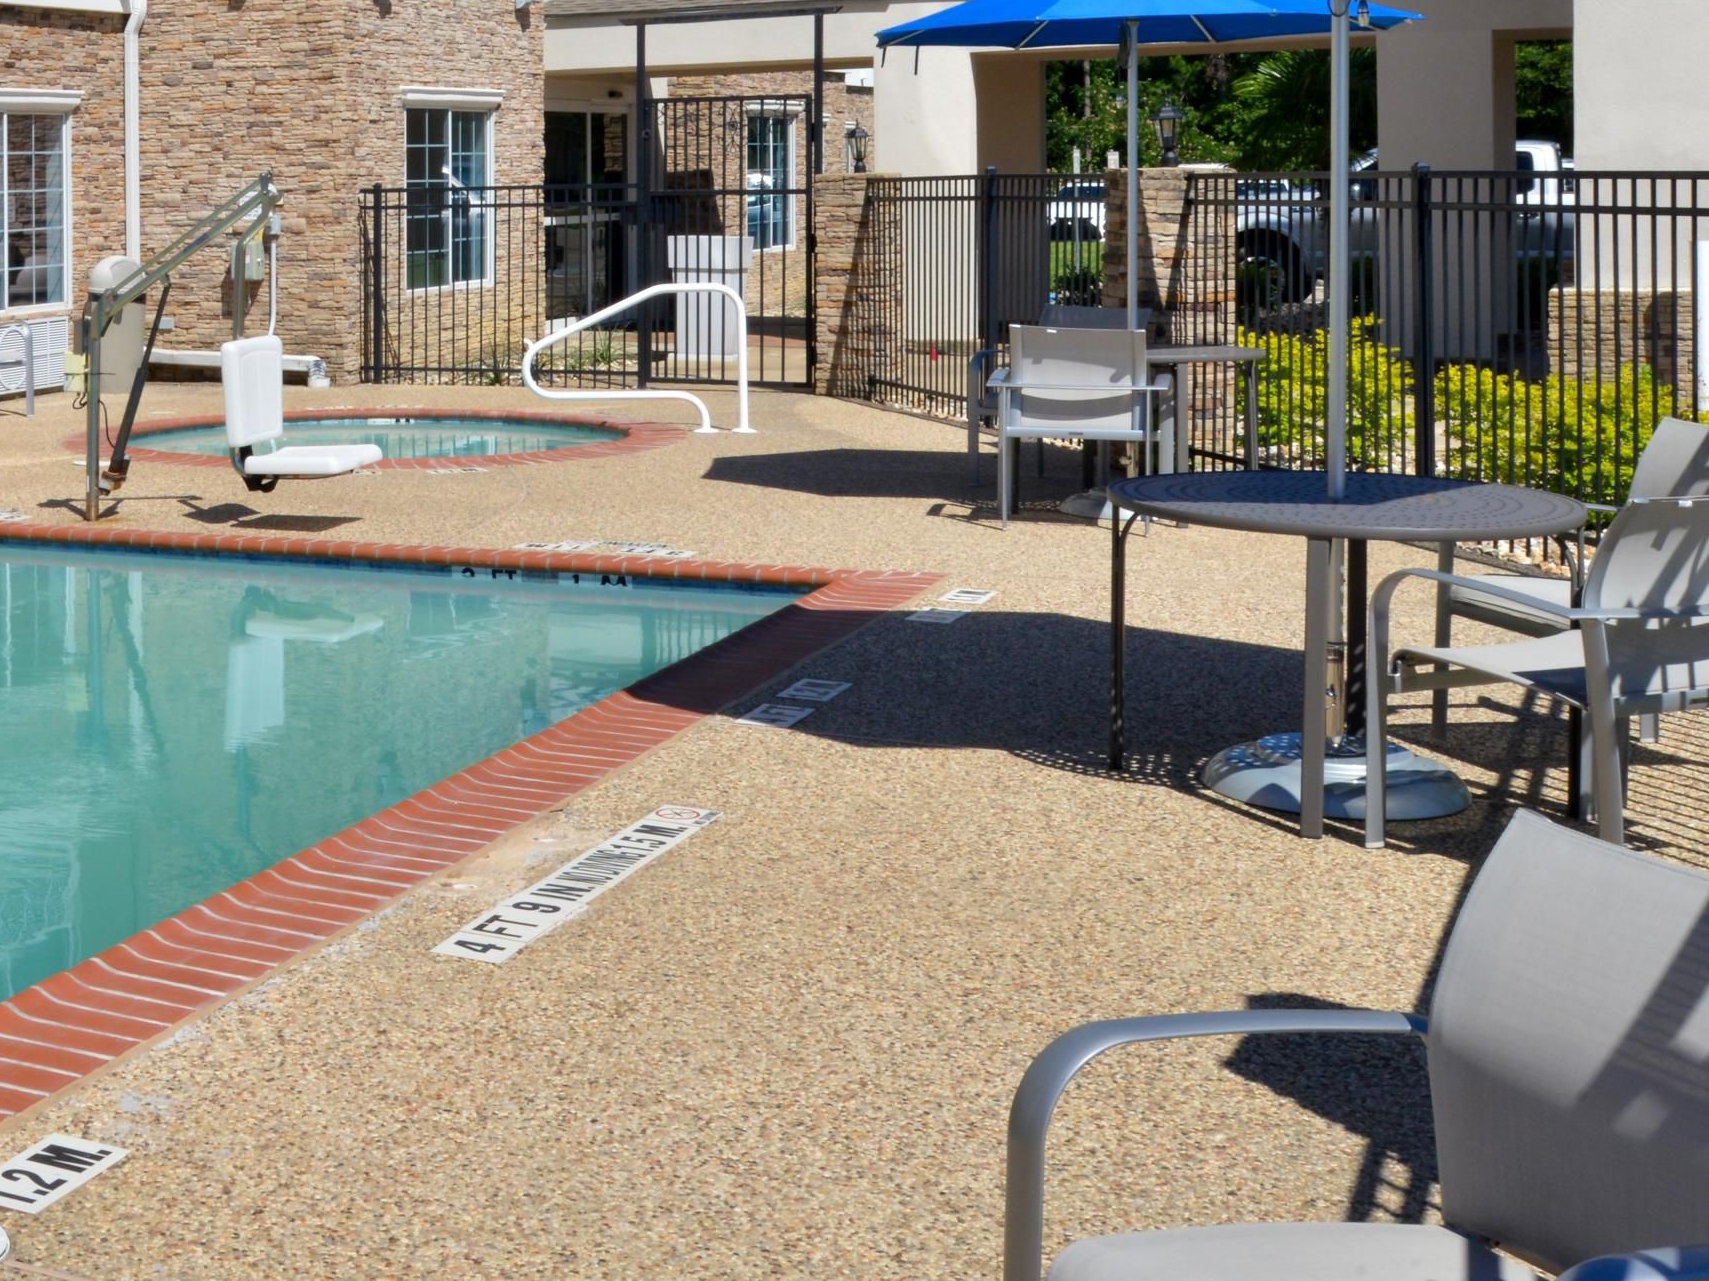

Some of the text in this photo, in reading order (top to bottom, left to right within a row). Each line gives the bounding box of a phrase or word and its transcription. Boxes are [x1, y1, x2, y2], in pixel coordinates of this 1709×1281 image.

[610, 835, 668, 852] 1.5
[511, 901, 562, 914] 9
[472, 914, 539, 939] FT
[453, 939, 507, 955] 4
[25, 1143, 113, 1174] M.
